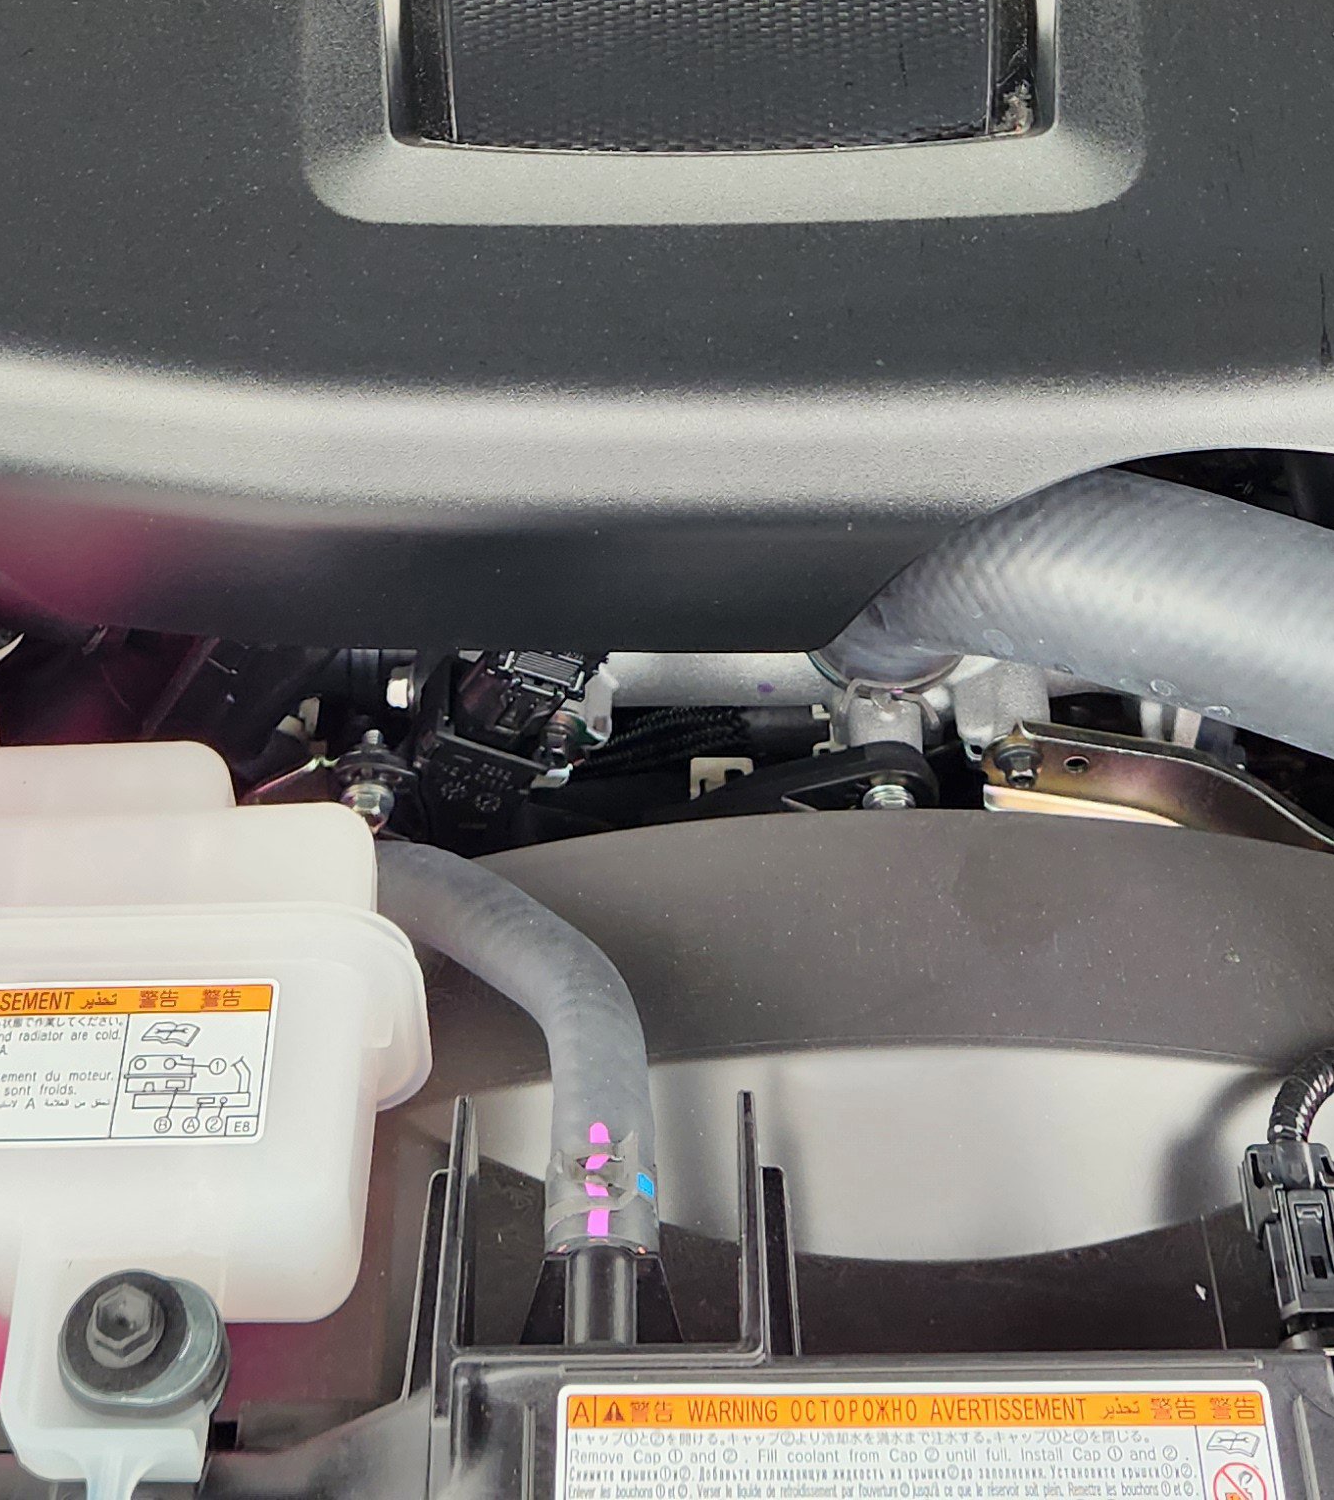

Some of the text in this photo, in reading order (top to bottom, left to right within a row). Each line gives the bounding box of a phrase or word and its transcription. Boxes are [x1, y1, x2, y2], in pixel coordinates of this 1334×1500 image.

[79, 992, 118, 1010] تحذير
[137, 989, 179, 1009] 警告
[199, 988, 242, 1008] 警告
[18, 1031, 63, 1041] radiator
[70, 1033, 88, 1041] are
[94, 1030, 122, 1040] cold.
[44, 1070, 60, 1081] du
[68, 1071, 114, 1081] moteur.
[3, 1086, 31, 1096] sont
[38, 1084, 78, 1096] froids.
[233, 1120, 251, 1133] E8
[572, 1401, 590, 1423] A
[687, 1399, 778, 1422] WARNING
[790, 1398, 917, 1421] ОСТОРОЖНО
[929, 1397, 1088, 1421] AVERTISSEMENT
[1101, 1397, 1141, 1420] تحذير
[1149, 1396, 1197, 1420] 警告
[1209, 1396, 1257, 1419] 警告
[569, 1448, 624, 1463] Remove
[633, 1448, 661, 1465] Cap
[689, 1448, 716, 1463] and
[757, 1448, 777, 1462] Fill
[787, 1447, 840, 1462] coolant
[848, 1447, 880, 1462] from
[888, 1447, 917, 1464] Cap
[945, 1447, 977, 1462] until
[985, 1447, 1011, 1462] full.
[1020, 1447, 1063, 1461] Install
[1072, 1446, 1101, 1463] Cap
[1129, 1446, 1156, 1461] and
[1120, 1482, 1159, 1496] bouchons
